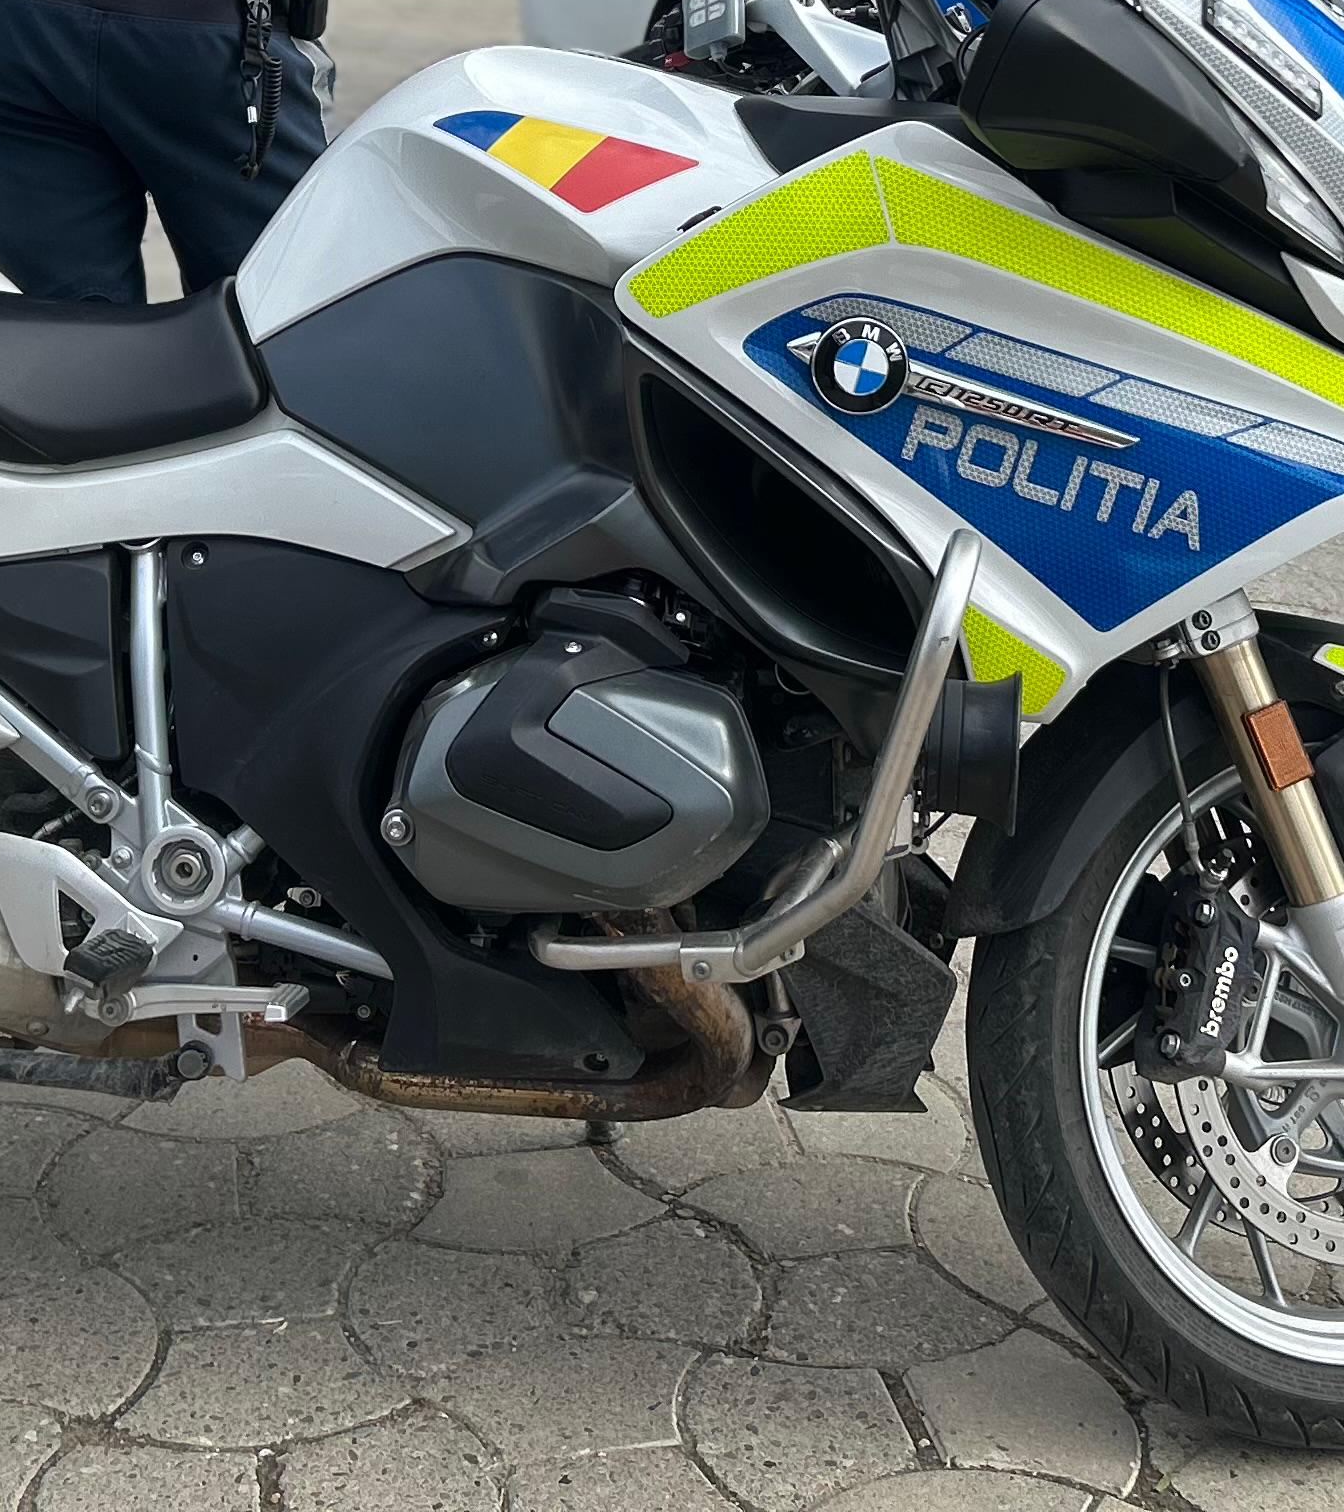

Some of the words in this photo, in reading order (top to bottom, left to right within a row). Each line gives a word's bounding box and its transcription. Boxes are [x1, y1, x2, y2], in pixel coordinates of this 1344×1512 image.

[833, 324, 904, 363] BMW
[900, 403, 1201, 552] POLITIA
[1199, 946, 1239, 1038] brembo
